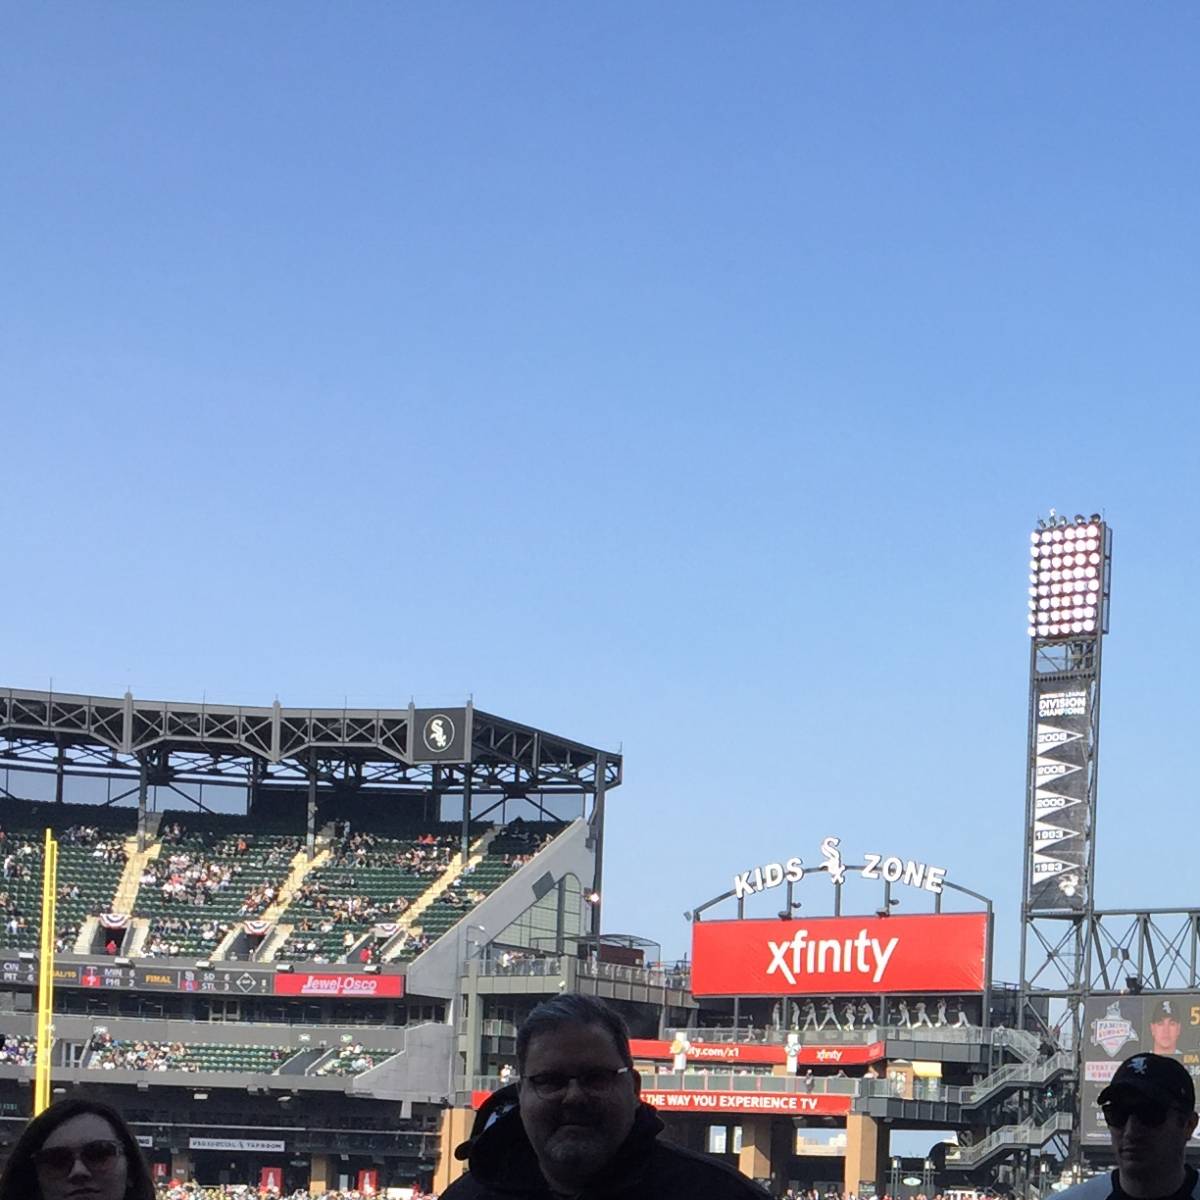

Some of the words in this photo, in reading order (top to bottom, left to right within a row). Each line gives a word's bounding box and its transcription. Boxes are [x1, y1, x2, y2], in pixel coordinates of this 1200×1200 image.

[1039, 698, 1086, 710] DIVISION
[734, 857, 804, 899] KIDS
[861, 854, 946, 894] ZONE
[767, 929, 899, 985] xfinity
[303, 975, 377, 992] Jewel-Osco
[646, 1094, 666, 1106] THE
[667, 1094, 696, 1107] WAY
[696, 1095, 718, 1107] YOU
[720, 1096, 797, 1109] EXPERIENCE
[801, 1098, 818, 1110] TV
